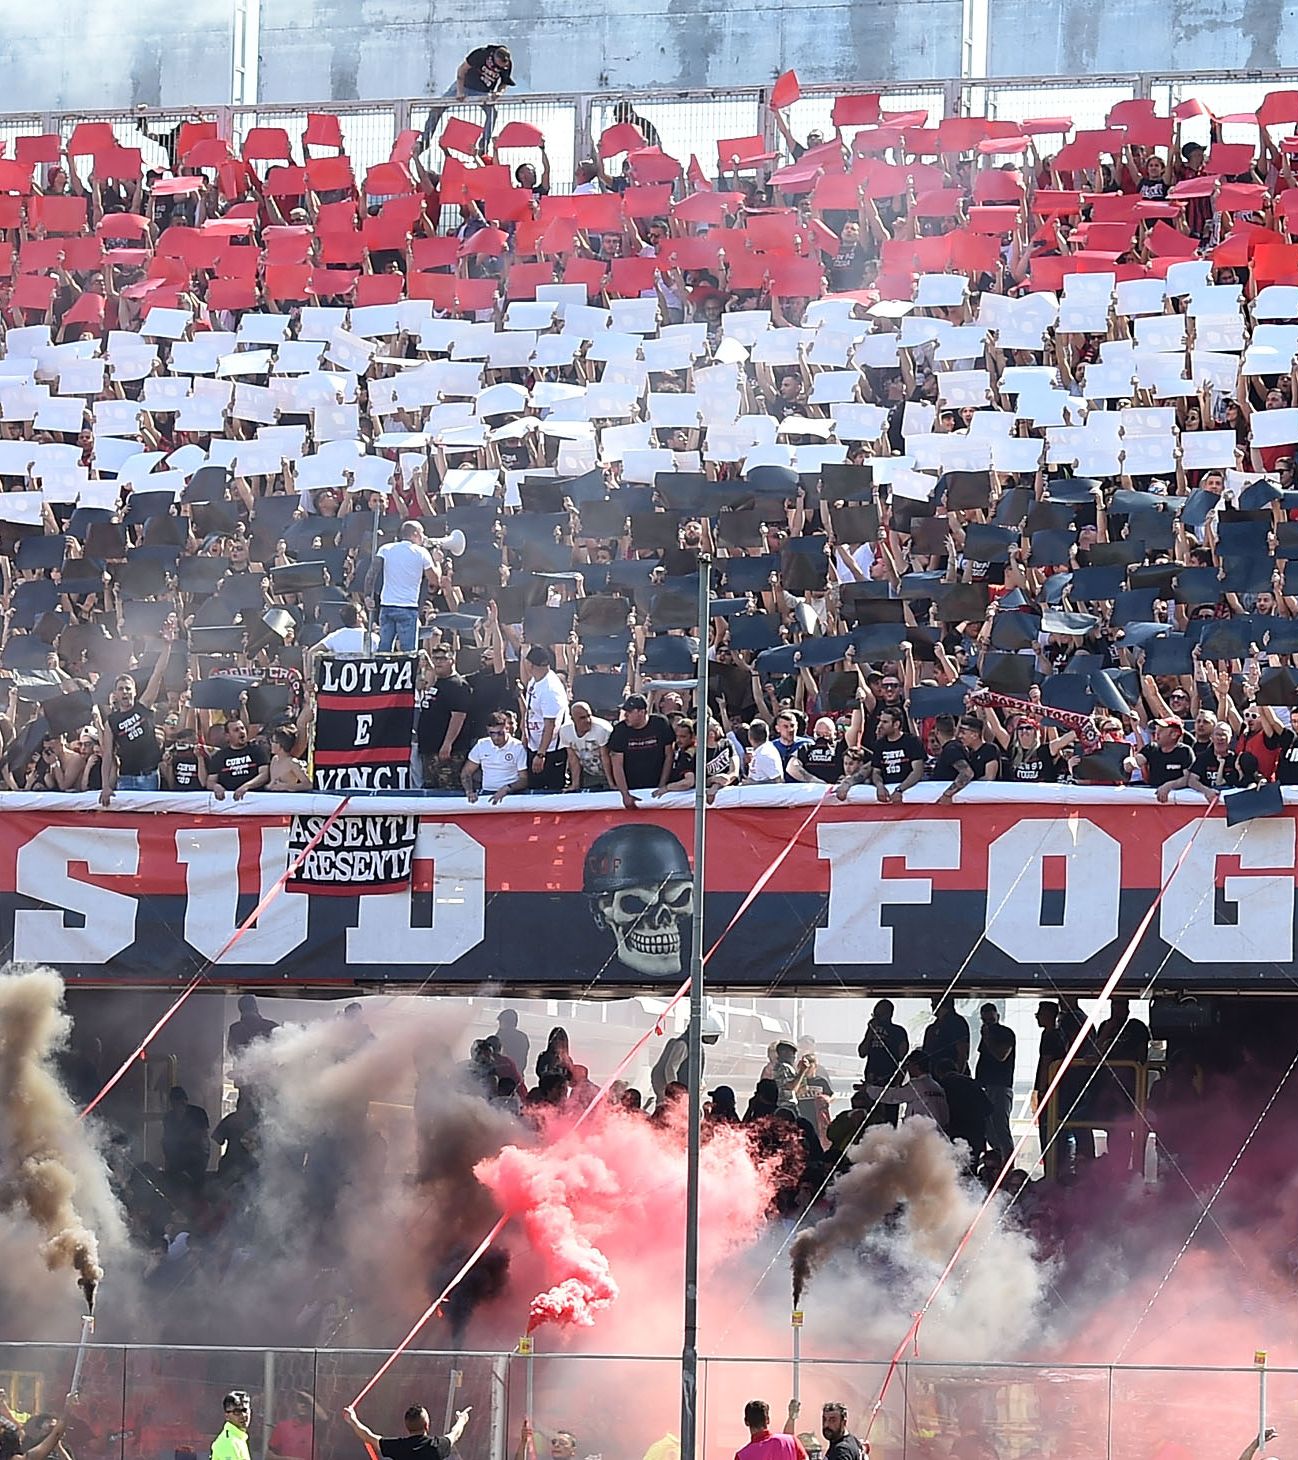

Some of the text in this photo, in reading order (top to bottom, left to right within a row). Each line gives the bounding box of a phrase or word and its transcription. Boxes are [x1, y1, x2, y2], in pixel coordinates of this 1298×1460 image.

[321, 660, 414, 693] LOTTA
[118, 712, 142, 731] CURVA
[127, 726, 144, 741] SUD
[353, 713, 374, 746] E
[225, 754, 253, 767] CURVA
[315, 765, 409, 791] VINCI
[289, 814, 416, 848] ASSENTI
[288, 845, 414, 882] PRESENTI
[14, 822, 486, 965] SUD
